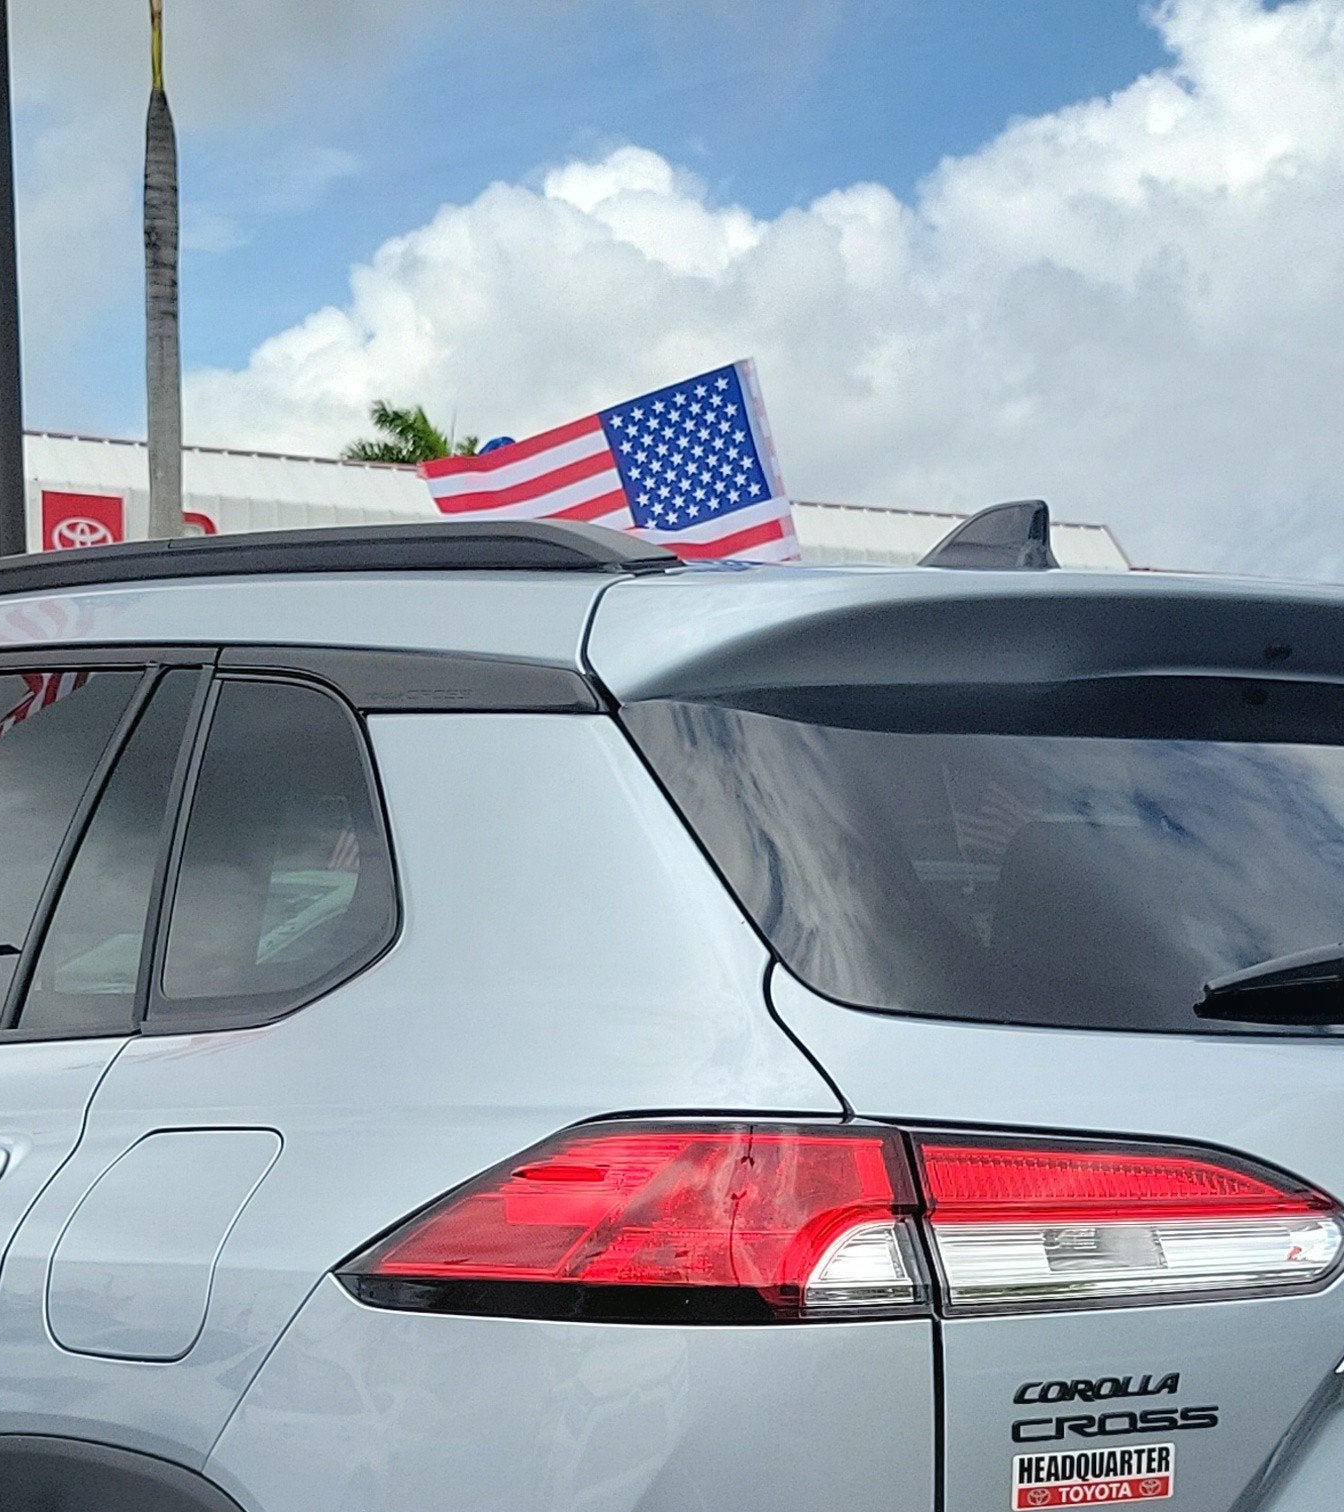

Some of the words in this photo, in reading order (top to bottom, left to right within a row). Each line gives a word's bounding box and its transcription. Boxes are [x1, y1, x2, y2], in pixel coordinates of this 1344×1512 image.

[1012, 1371, 1180, 1405] COROLLA
[1011, 1404, 1219, 1444] CROSS
[1017, 1446, 1171, 1485] HEADQUARTER
[1057, 1482, 1133, 1504] TOYOTA
